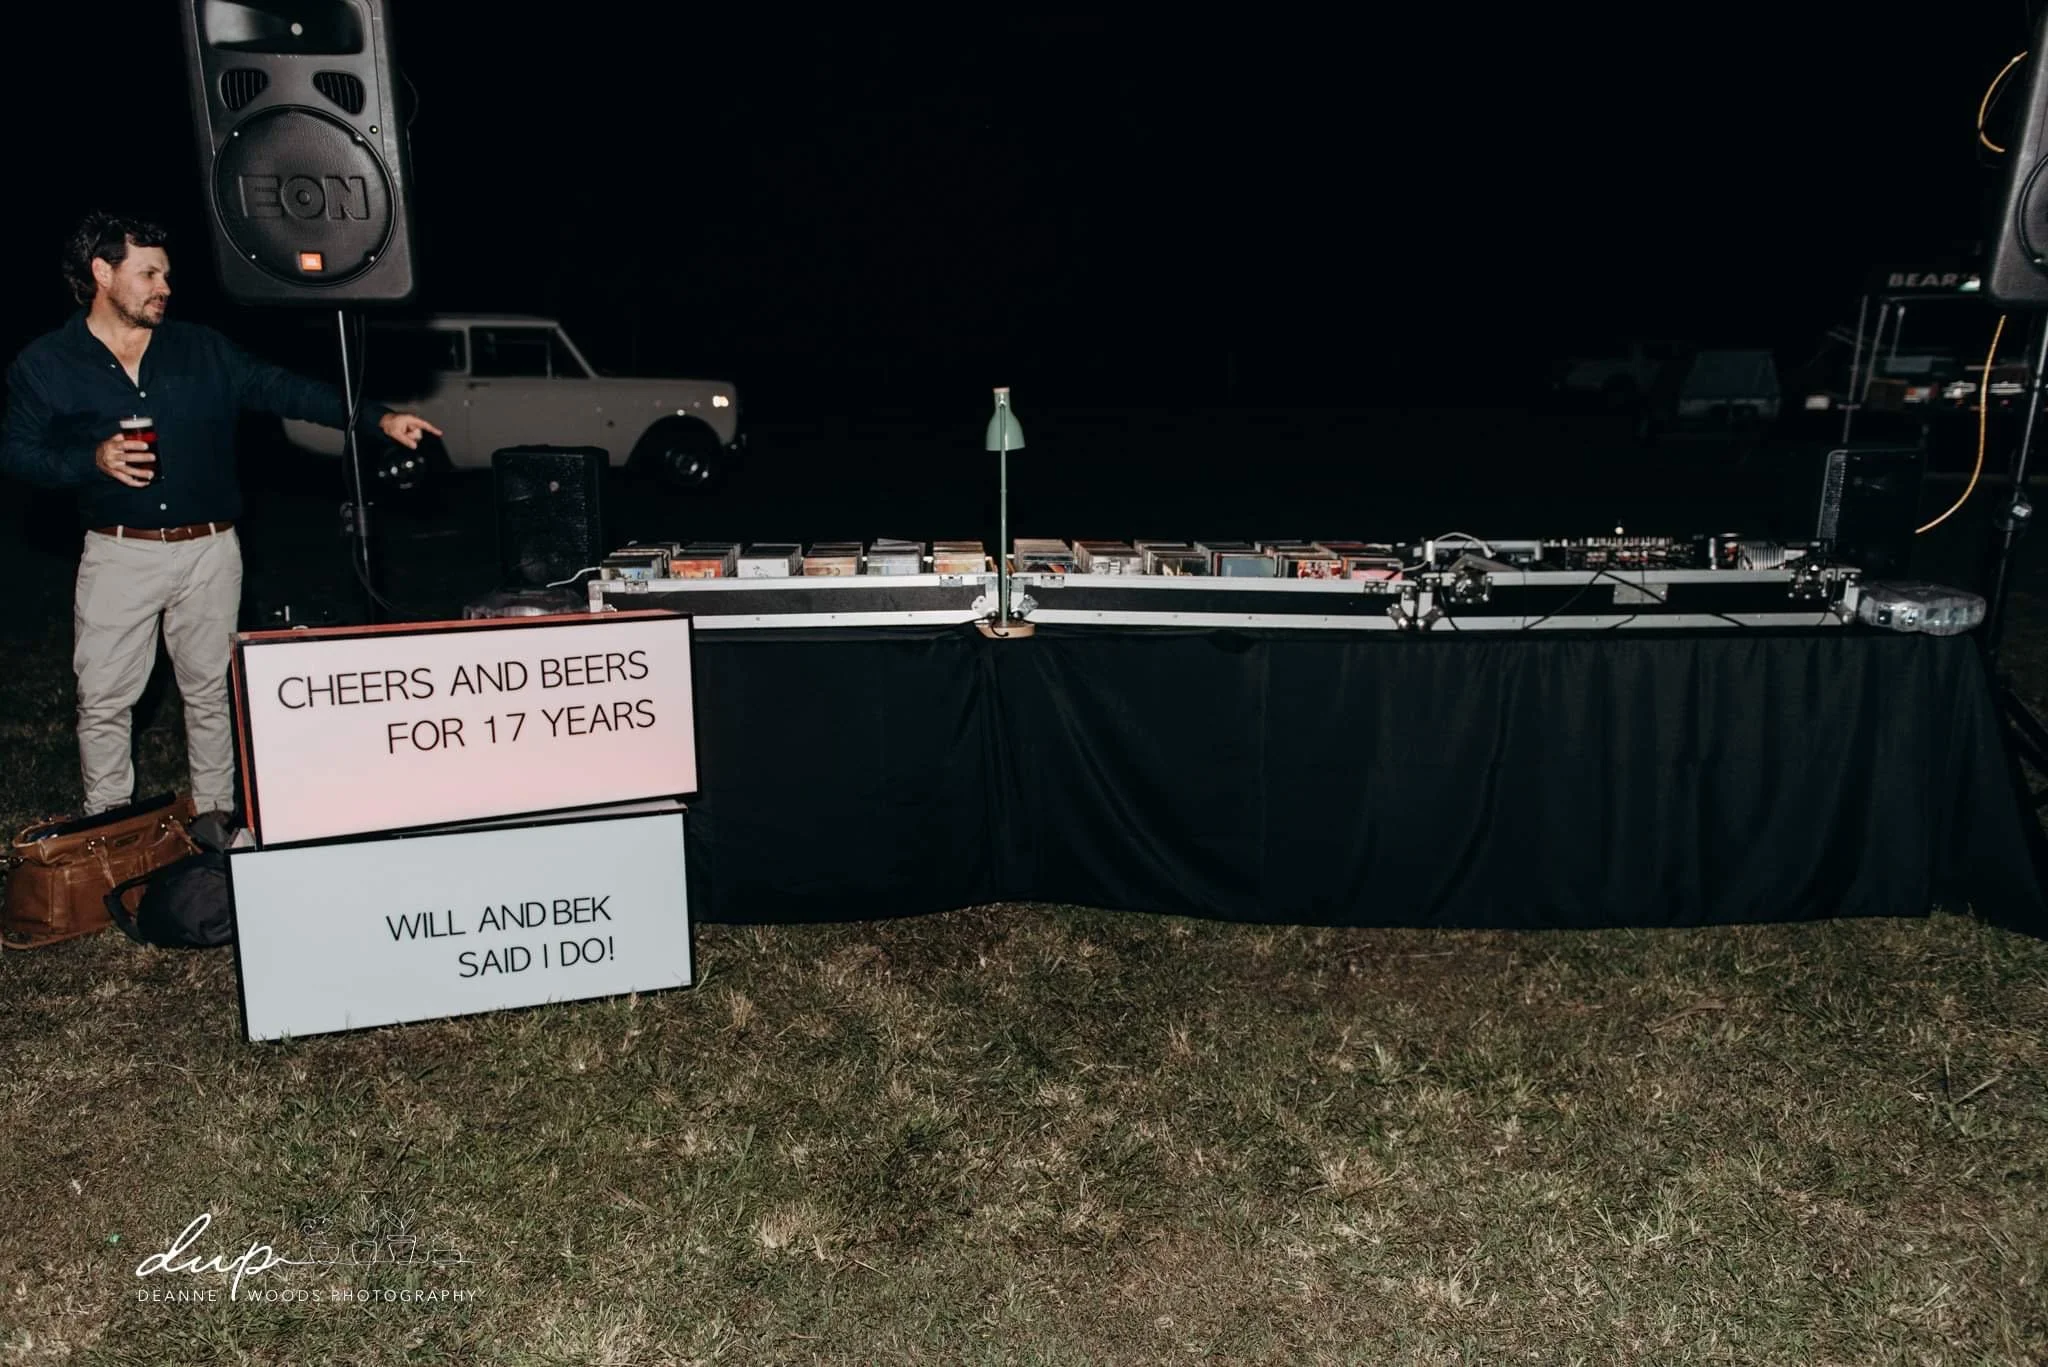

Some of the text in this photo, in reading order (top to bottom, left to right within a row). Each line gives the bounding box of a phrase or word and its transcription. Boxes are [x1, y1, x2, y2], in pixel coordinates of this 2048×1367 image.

[238, 174, 370, 221] EON
[277, 650, 650, 710] CHEERS AND BEERS
[387, 698, 657, 755] FOR 17 YEARS
[385, 895, 613, 942] WILL AND BEK
[457, 935, 615, 979] SAID I DO!
